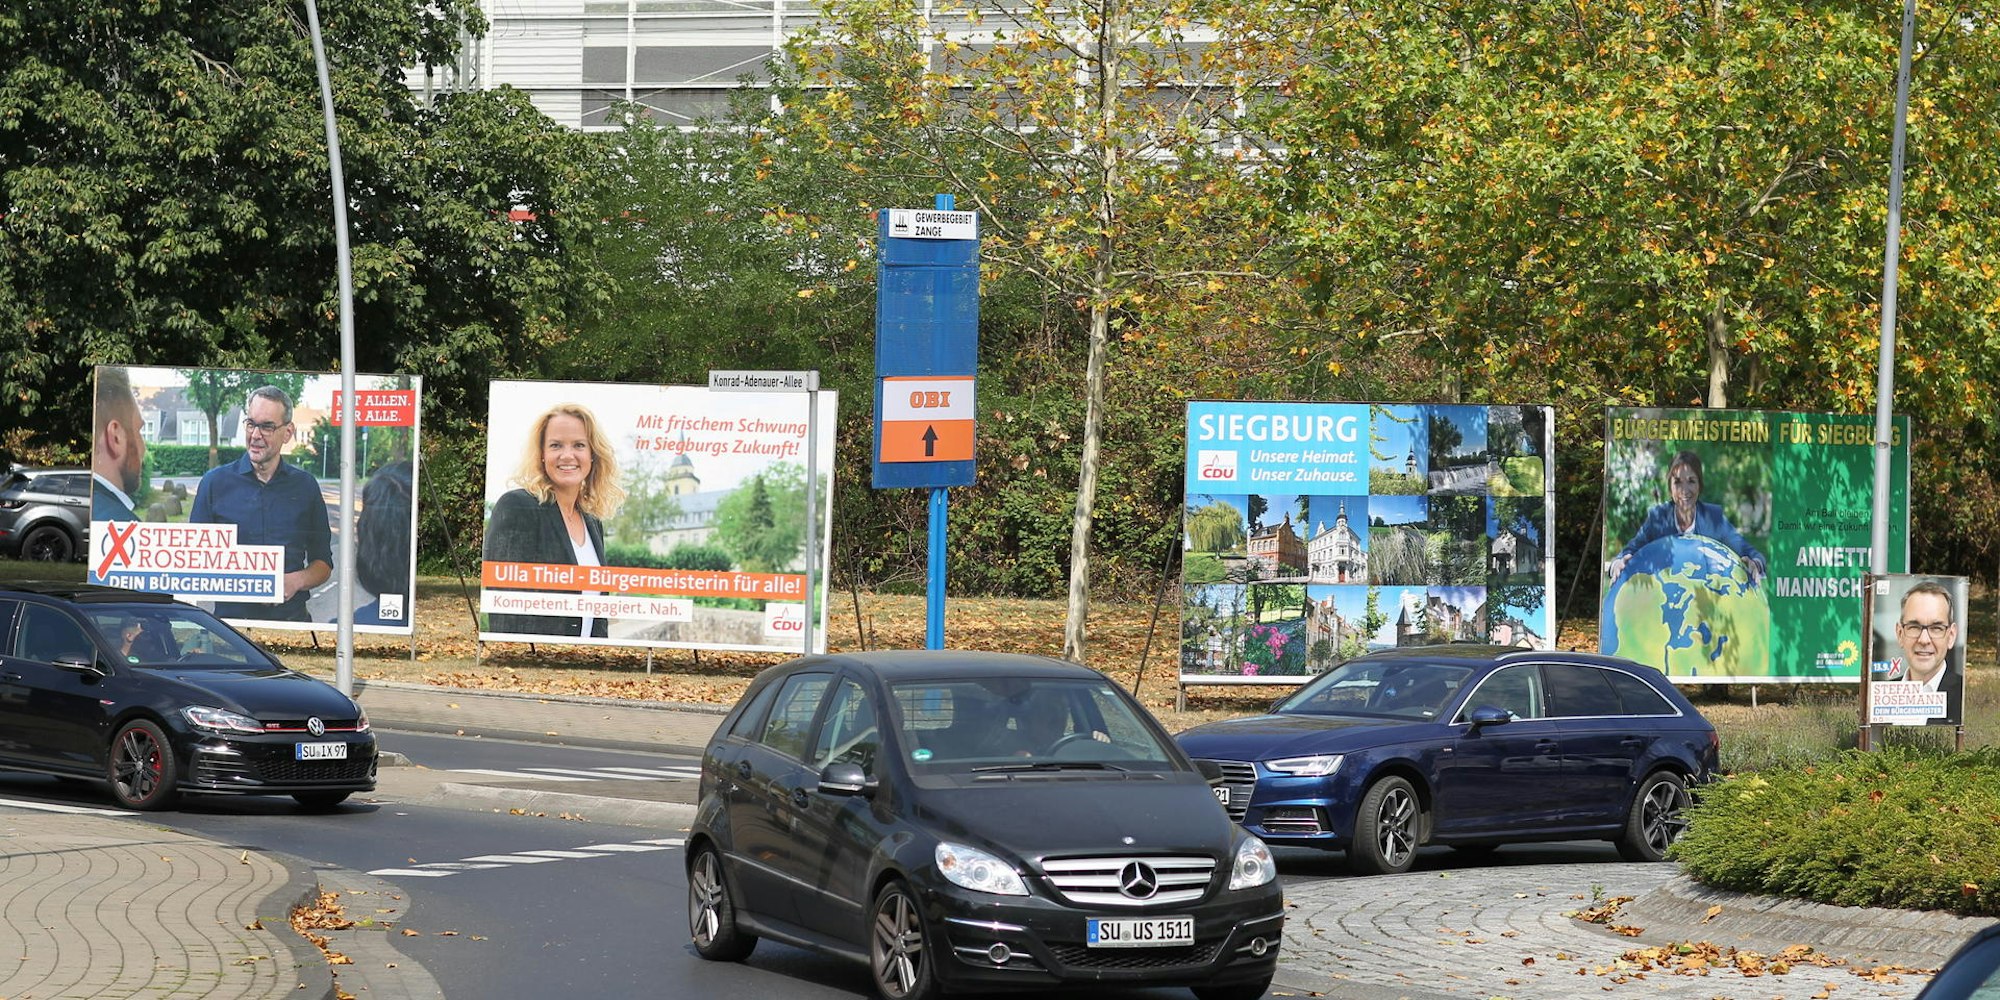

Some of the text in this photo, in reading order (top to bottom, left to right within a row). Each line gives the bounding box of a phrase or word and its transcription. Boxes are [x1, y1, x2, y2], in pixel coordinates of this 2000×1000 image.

[915, 212, 972, 224] GEWERBEGEBIET
[915, 226, 942, 236] ZANGE
[713, 374, 803, 388] Konrad-Adenauer-Allee
[365, 395, 411, 406] ALLEN.
[909, 391, 951, 408] OBI
[336, 410, 402, 421] FR ALLE.
[636, 415, 807, 438] Mit frischem Schwung
[1199, 414, 1358, 442] SIEGBURG
[1613, 414, 1901, 447] BÜRGERMEISTERIN FÜR SIEGBUG
[635, 436, 800, 459] in Siegburgs Zukunft!
[1250, 450, 1358, 464] Unsere Heimat.
[1202, 468, 1233, 479] CDU
[1251, 468, 1358, 482] Unser Zuhause.
[139, 528, 232, 548] STEFAN
[138, 549, 278, 571] ROSEMANN
[1796, 546, 1872, 567] ANNETT
[109, 574, 272, 593] DEIN BÜRGERMEISTER
[495, 565, 528, 582] Ulla
[533, 567, 574, 584] Thiel
[589, 570, 729, 591] Bürgermeisterin
[733, 574, 759, 592] für
[763, 576, 801, 594] alle!
[1776, 577, 1862, 597] MANNSCH
[381, 609, 399, 617] SPD
[494, 595, 682, 616] Kompetent. Engagiert. Nah.
[772, 620, 803, 631] CDU
[1874, 684, 1920, 694] STEFAN
[1874, 695, 1944, 705] ROSEMANN
[303, 745, 316, 757] SU
[321, 745, 333, 757] IX
[335, 745, 346, 757] 97
[1100, 923, 1120, 940] SU
[1134, 922, 1153, 940] US
[1158, 921, 1191, 939] 1511
